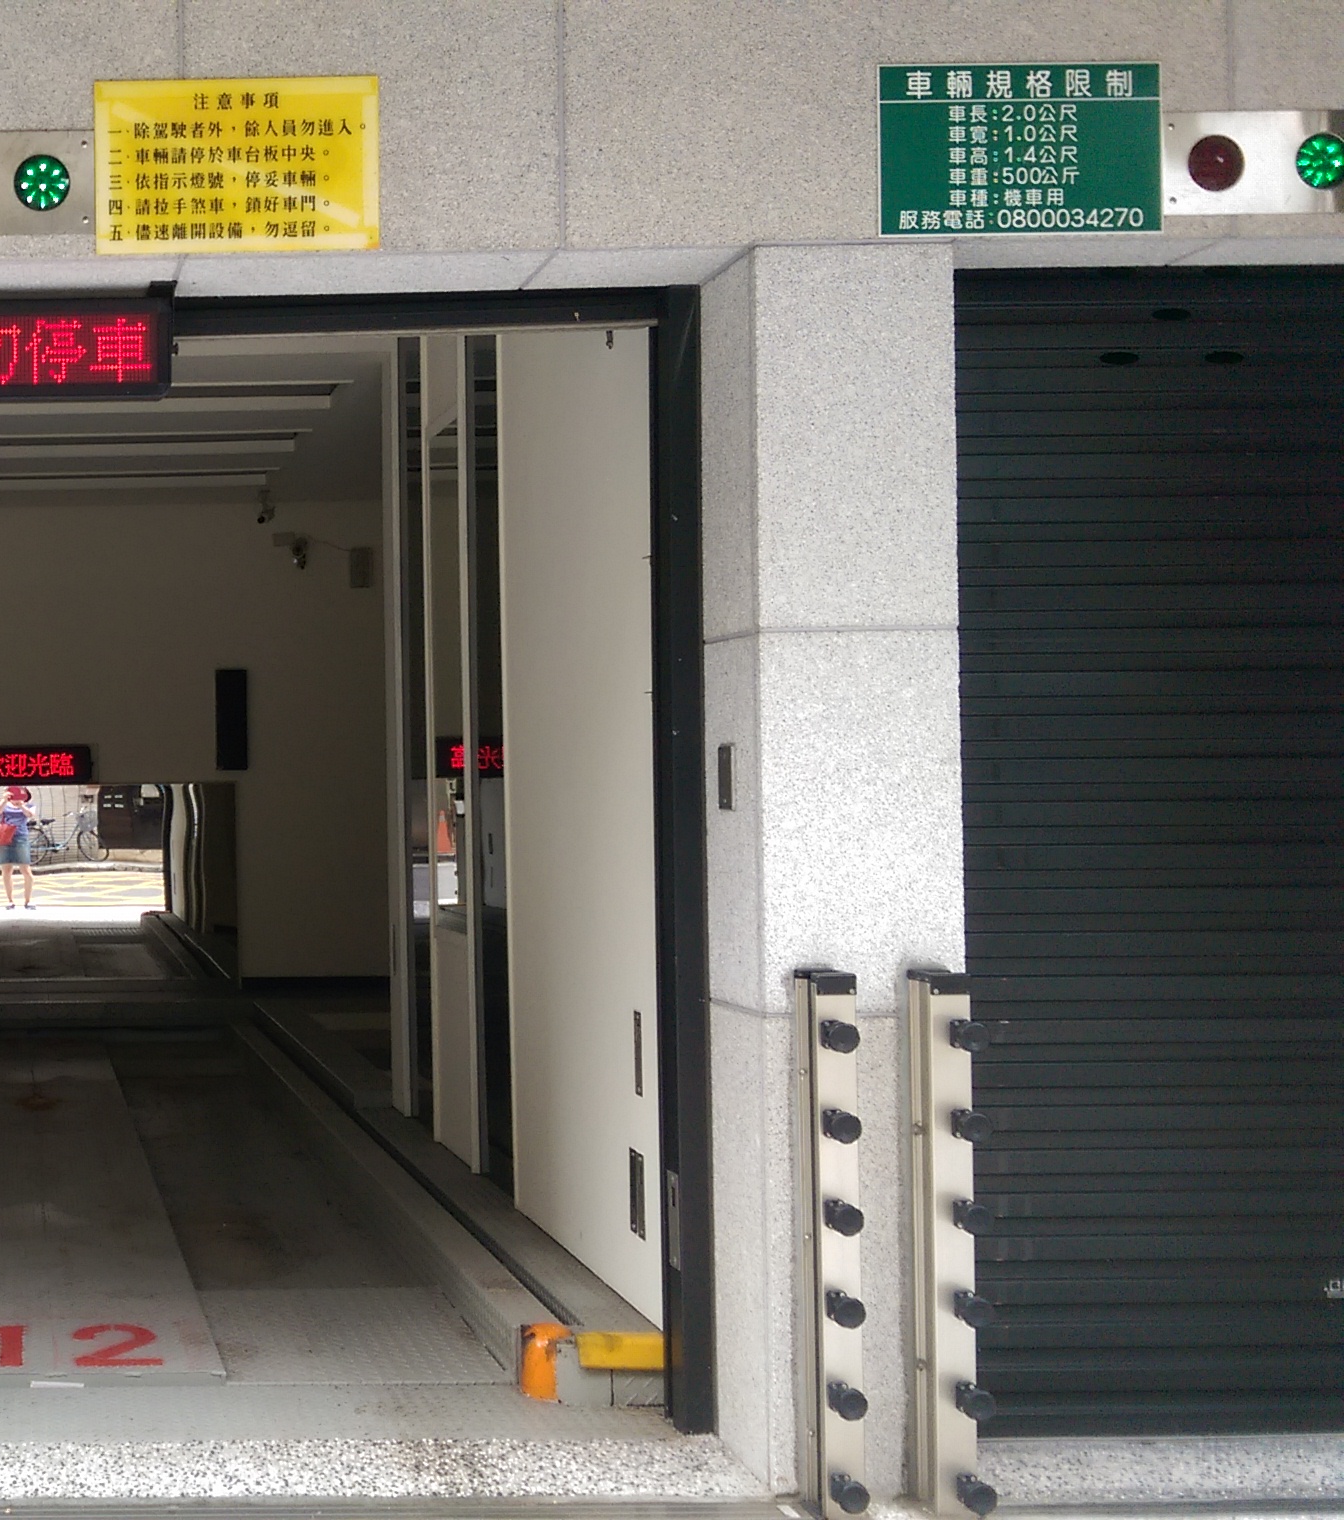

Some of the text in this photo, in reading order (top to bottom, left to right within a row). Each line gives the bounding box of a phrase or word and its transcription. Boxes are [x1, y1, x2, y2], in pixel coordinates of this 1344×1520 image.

[906, 69, 1133, 99] 車輛規格限制
[193, 92, 280, 111] 注意事項
